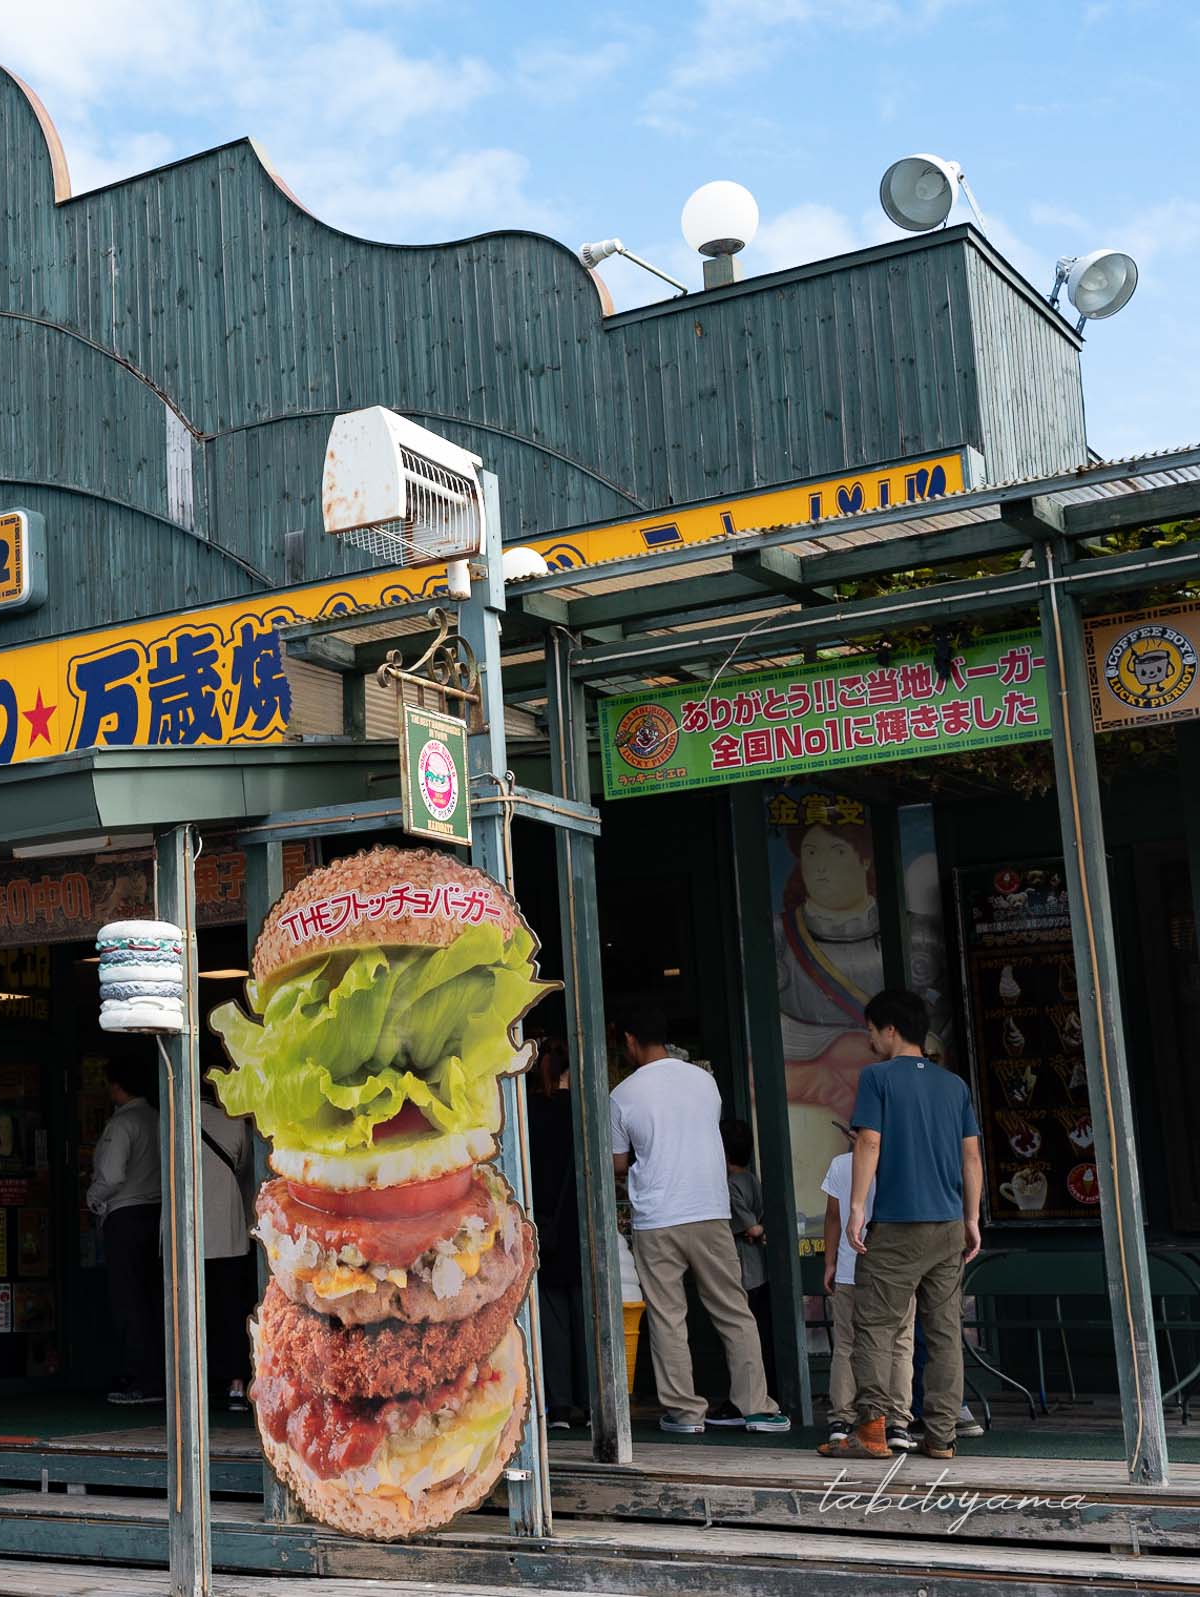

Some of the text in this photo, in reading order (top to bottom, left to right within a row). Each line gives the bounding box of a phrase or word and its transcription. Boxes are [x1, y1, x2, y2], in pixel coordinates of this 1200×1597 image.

[1108, 626, 1193, 666] COFFEE BOY
[1109, 665, 1195, 708] LUCKY PIERROT
[621, 706, 673, 729] HAMBURGER
[710, 691, 1039, 770] 全国No1に輝きました
